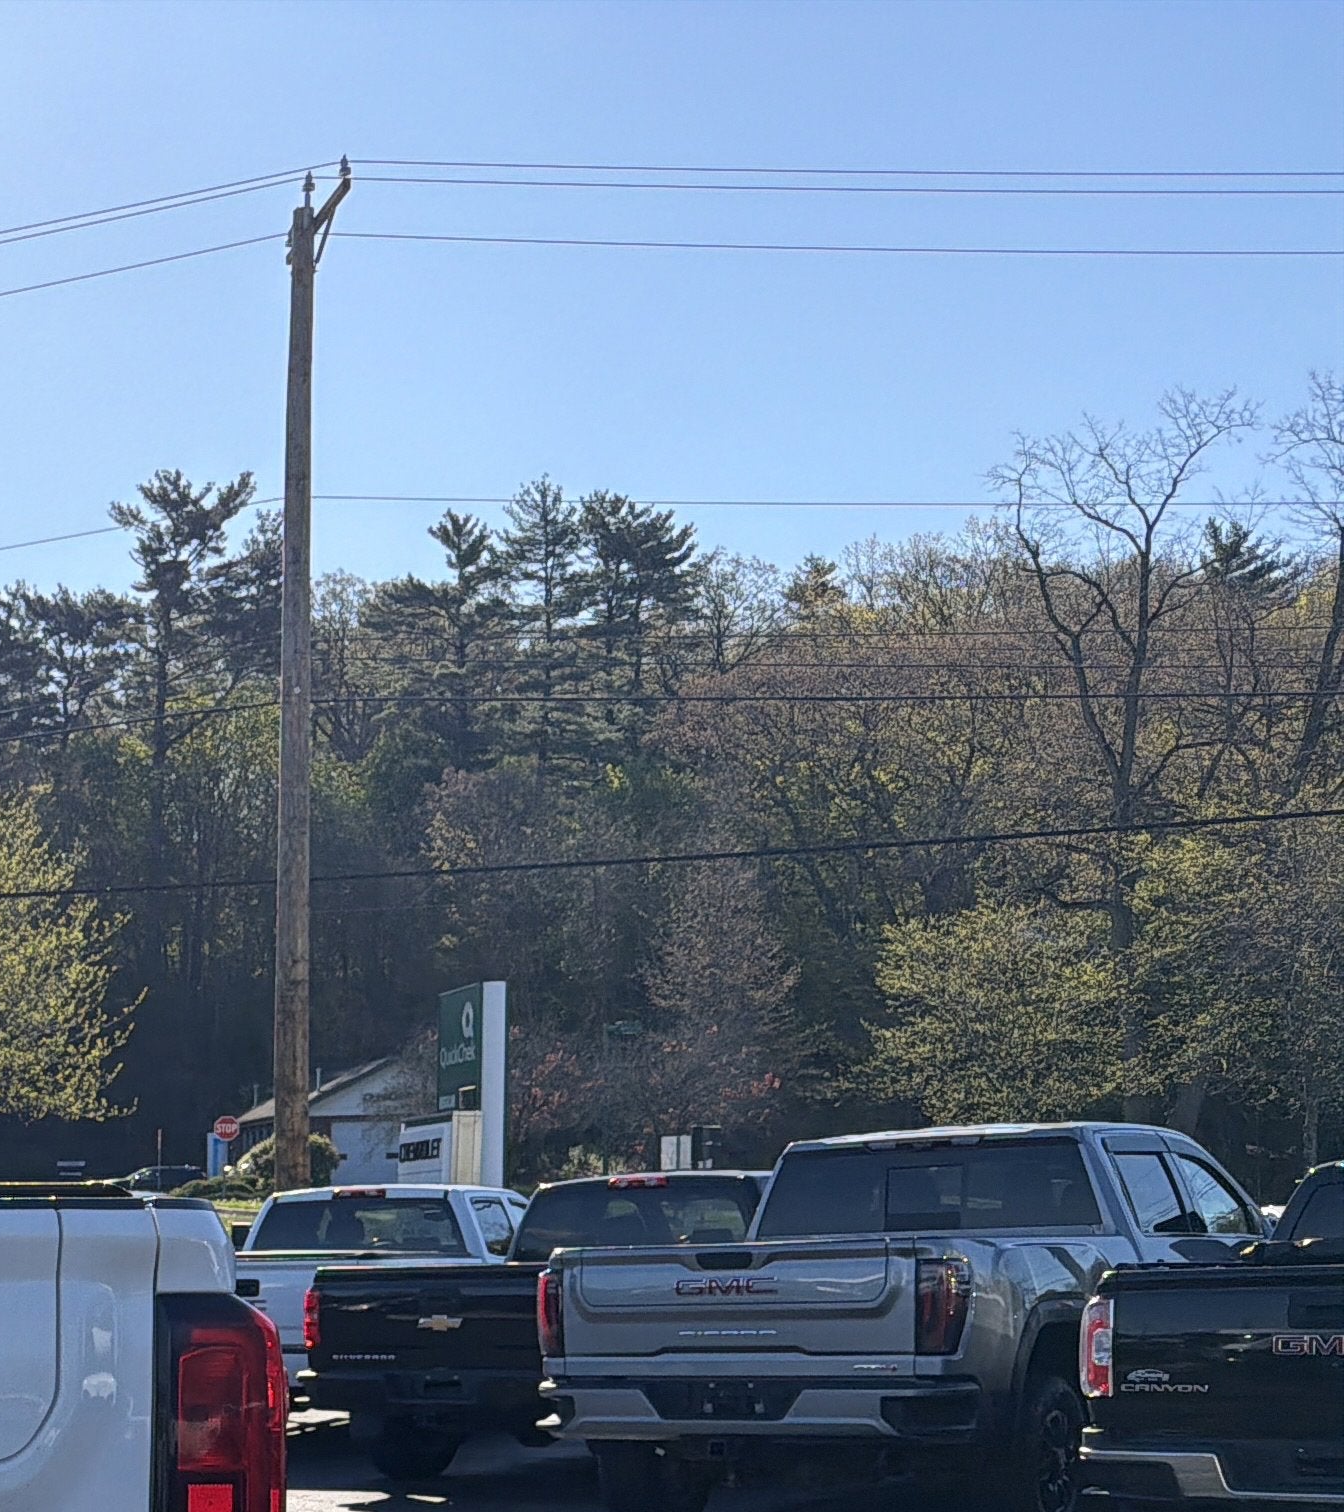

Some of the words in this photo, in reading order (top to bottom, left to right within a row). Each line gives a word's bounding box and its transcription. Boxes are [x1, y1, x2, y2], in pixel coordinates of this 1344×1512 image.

[216, 1123, 238, 1134] STOP
[674, 1276, 779, 1297] GMC
[1120, 1382, 1209, 1394] CANYON
